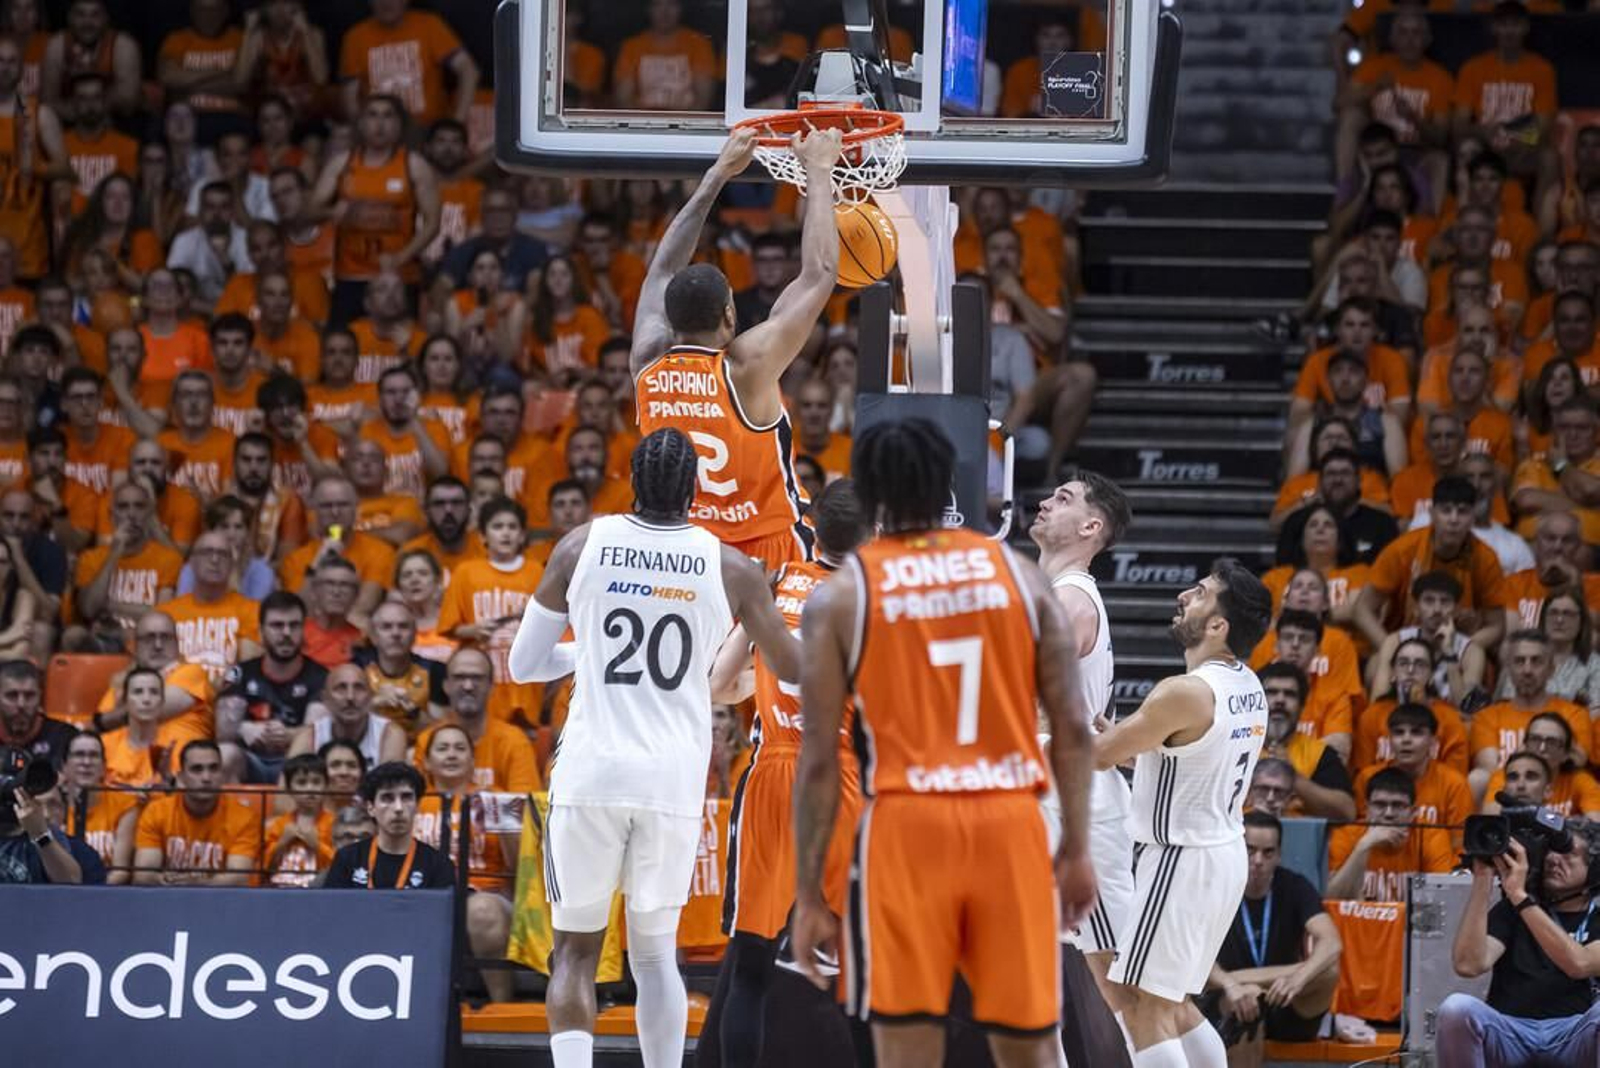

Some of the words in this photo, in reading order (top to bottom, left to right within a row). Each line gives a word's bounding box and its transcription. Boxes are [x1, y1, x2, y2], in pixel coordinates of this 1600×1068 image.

[1147, 354, 1226, 381] Torres
[645, 370, 718, 396] SORIANO
[1138, 450, 1220, 480] Torres
[600, 546, 706, 576] FERNANDO
[880, 548, 996, 593] JONES
[1112, 553, 1198, 582] Torres
[606, 581, 697, 602] AUTOHERO
[603, 607, 693, 692] 20
[927, 636, 983, 746] 7
